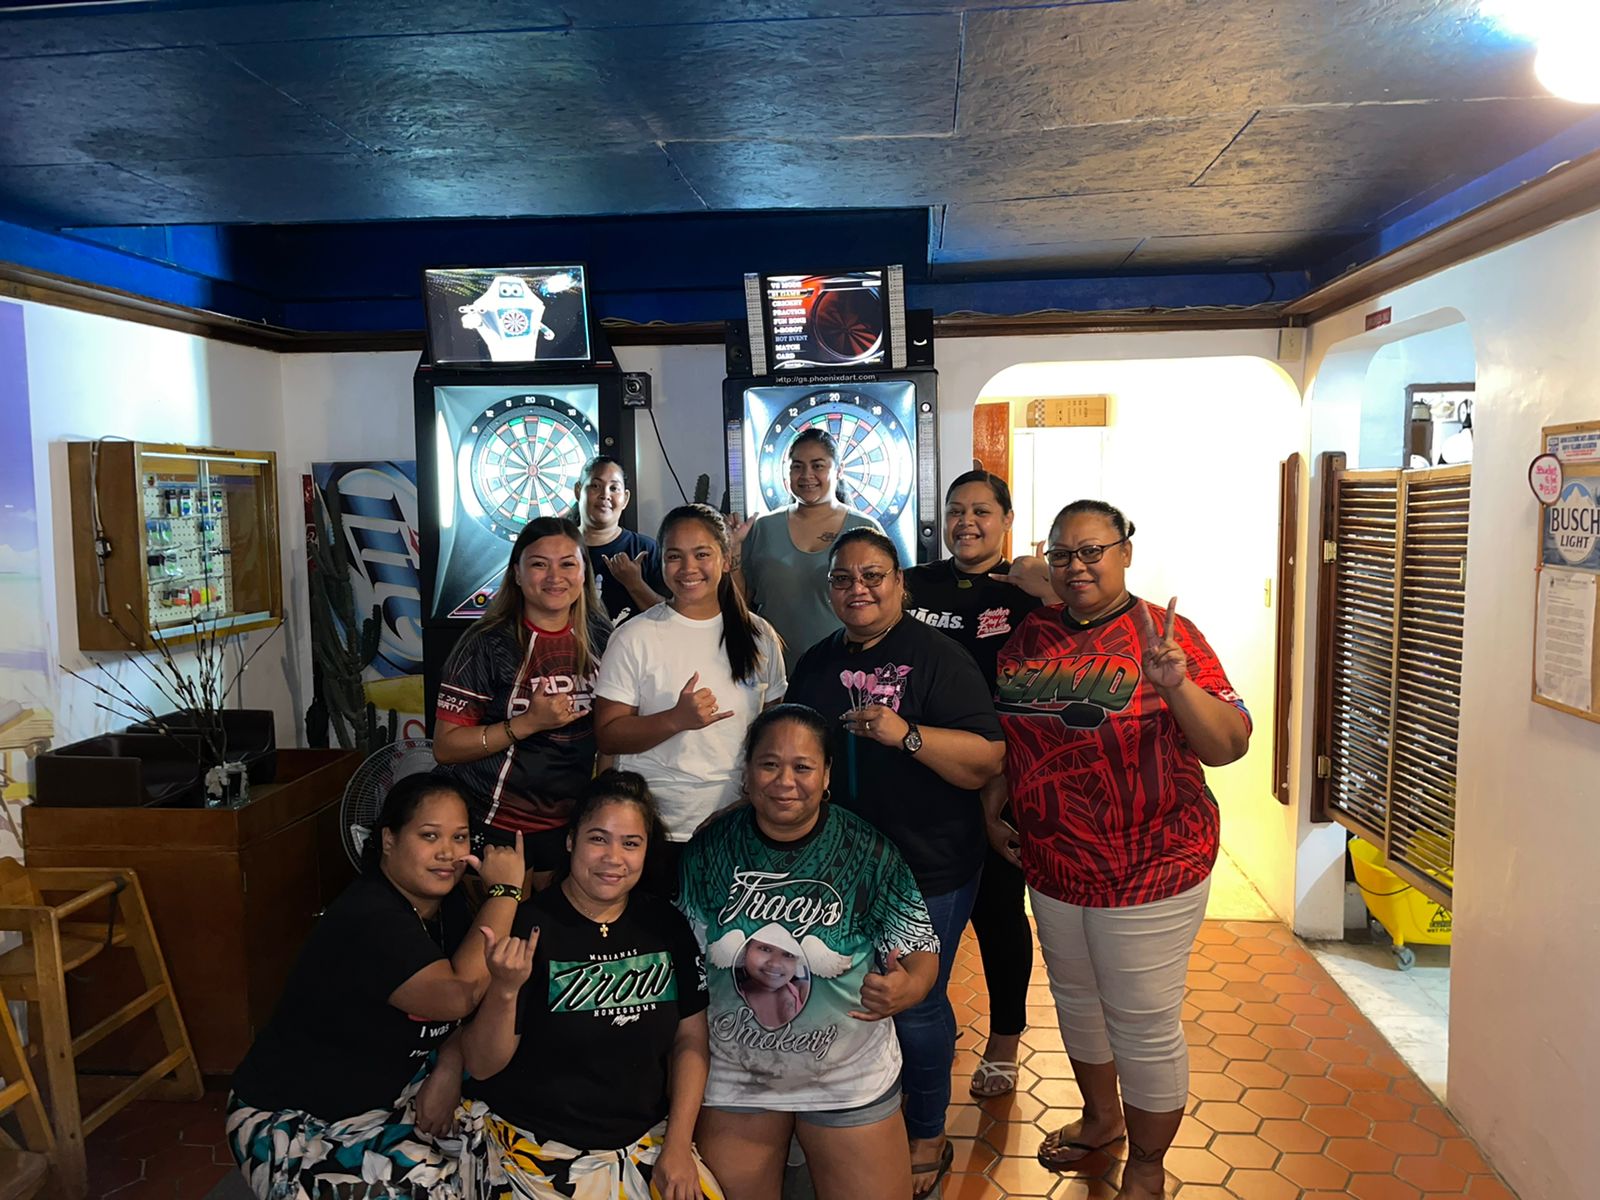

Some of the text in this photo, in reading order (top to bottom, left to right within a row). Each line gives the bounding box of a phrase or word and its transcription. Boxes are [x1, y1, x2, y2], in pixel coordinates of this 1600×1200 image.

[810, 397, 816, 406] 5
[829, 392, 840, 401] 20
[854, 396, 859, 405] 1
[788, 408, 798, 416] 12
[584, 424, 591, 432] 4
[1551, 507, 1600, 535] BUSCH
[1560, 535, 1590, 549] LIGHT
[717, 865, 844, 938] Tracy's
[590, 948, 638, 961] MARIANAS
[594, 1002, 657, 1017] HOMEGROWN
